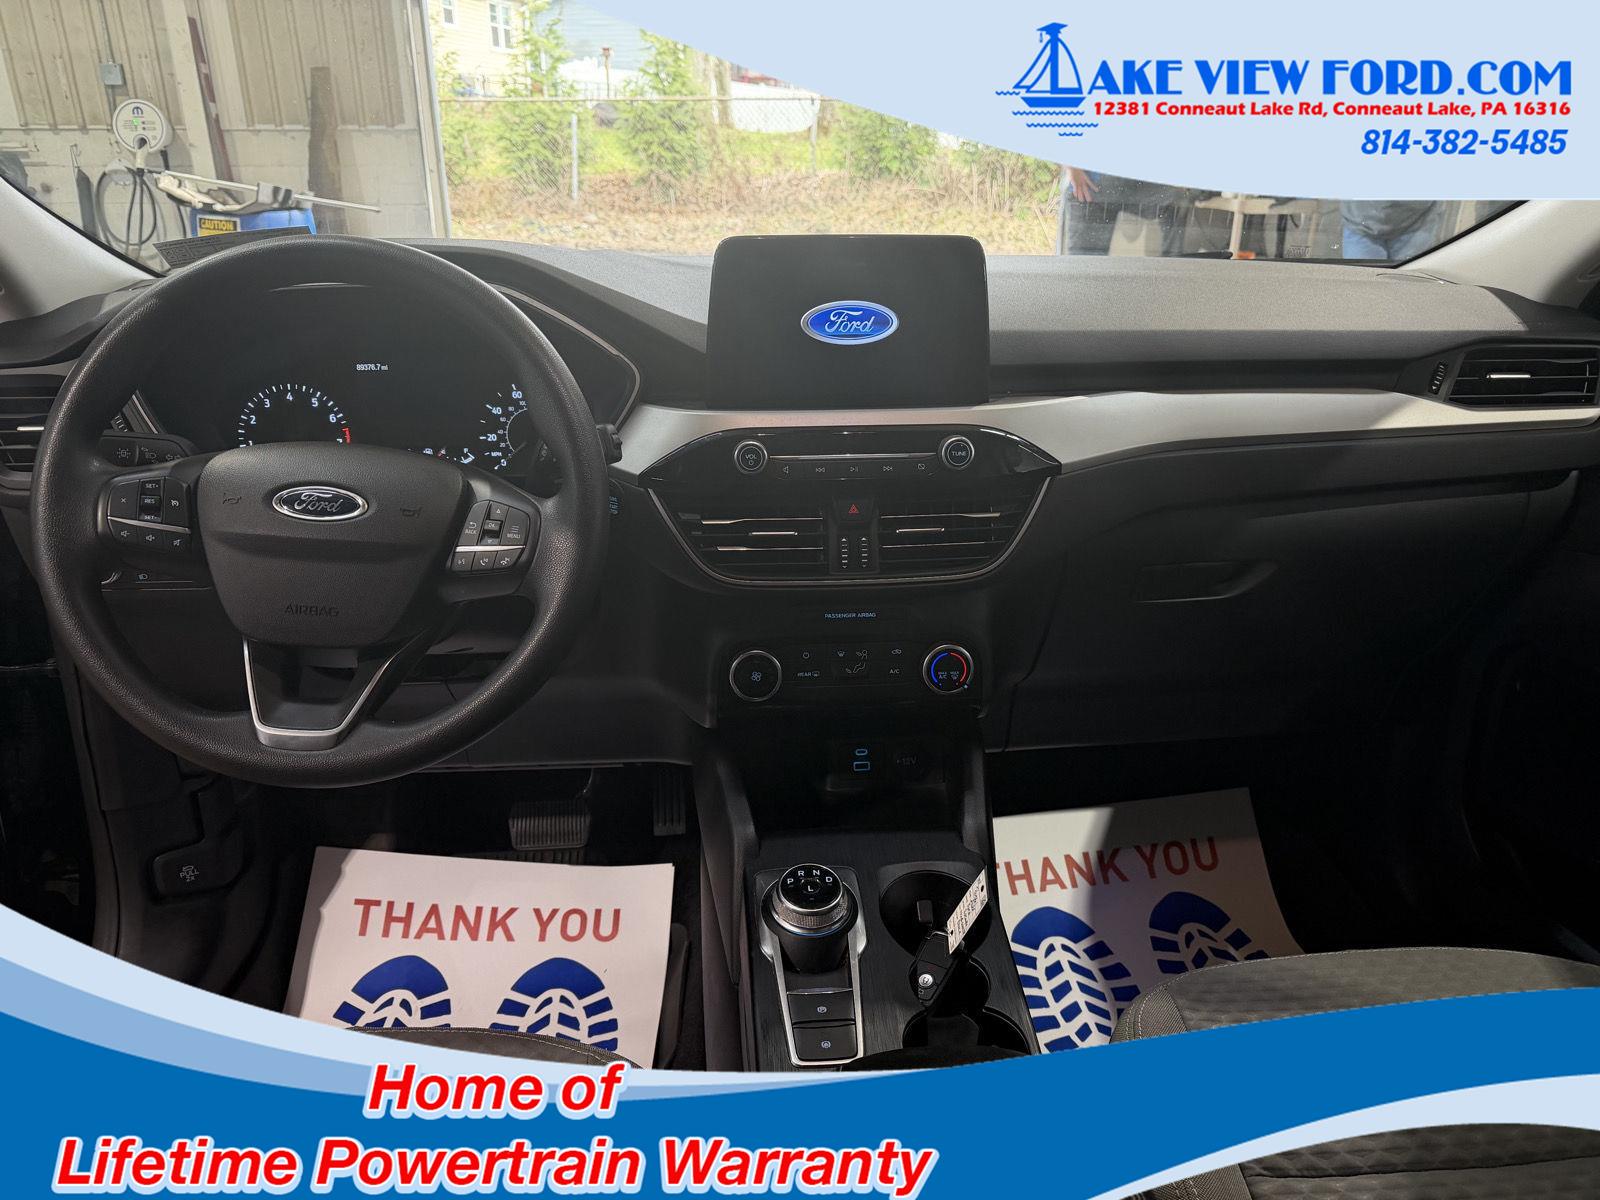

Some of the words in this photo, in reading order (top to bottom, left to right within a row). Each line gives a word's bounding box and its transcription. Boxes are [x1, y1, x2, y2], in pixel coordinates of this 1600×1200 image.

[825, 309, 875, 332] Ford
[286, 392, 293, 401] 4
[512, 391, 522, 399] 60
[263, 399, 270, 408] 3
[311, 398, 319, 407] 5
[491, 407, 502, 415] 40
[249, 415, 257, 425] 2
[329, 413, 337, 423] 6
[294, 491, 344, 513] Ford
[284, 603, 340, 617] AIRBAG
[996, 847, 1129, 896] HANK
[1135, 836, 1219, 880] YOU
[353, 898, 519, 942] THANK
[532, 907, 622, 942] YOU
